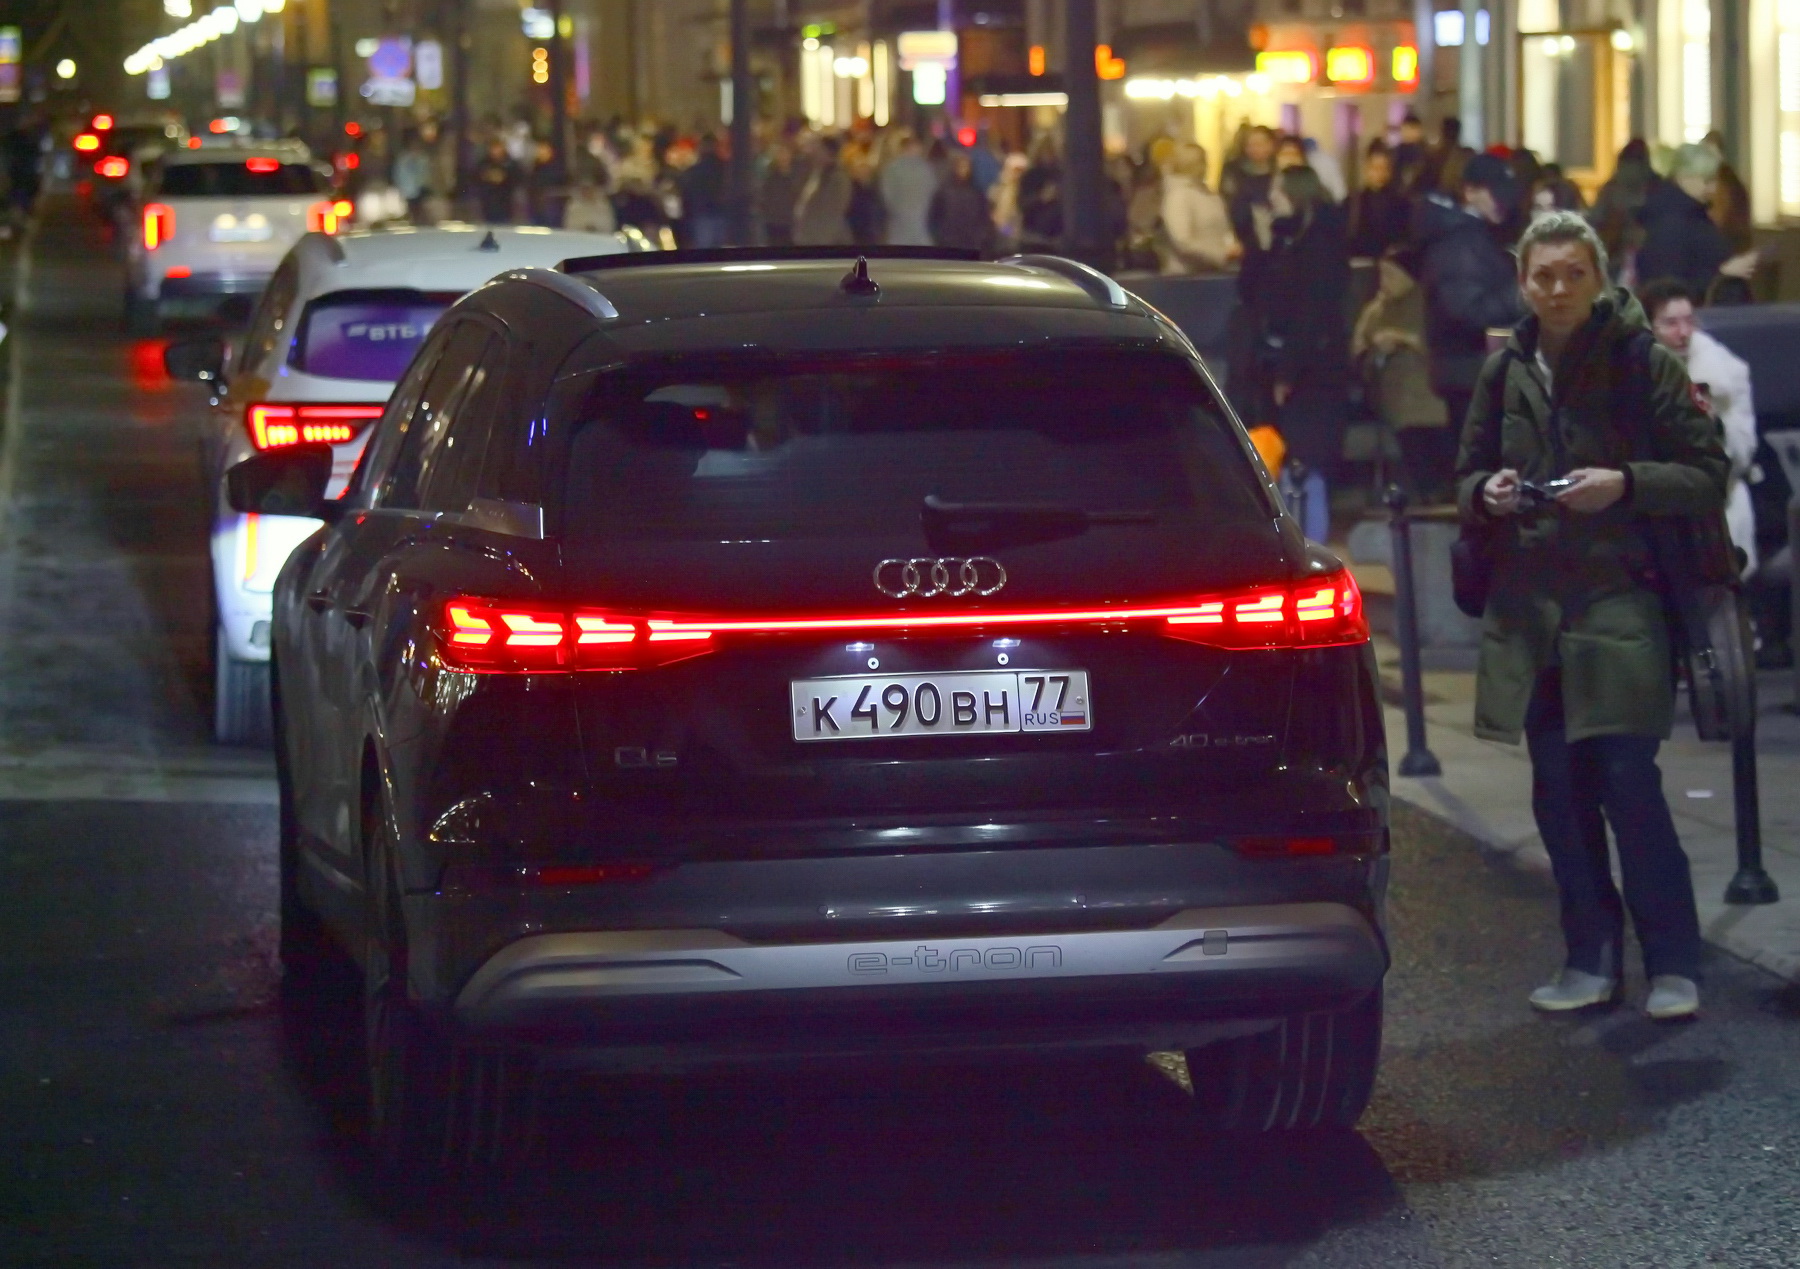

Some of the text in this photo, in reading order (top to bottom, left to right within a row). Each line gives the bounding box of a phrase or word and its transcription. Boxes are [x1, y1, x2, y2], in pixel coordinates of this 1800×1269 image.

[368, 323, 417, 341] ВТБ
[1024, 675, 1070, 711] 77
[1025, 712, 1059, 725] RUS
[847, 945, 1062, 975] e-tron
